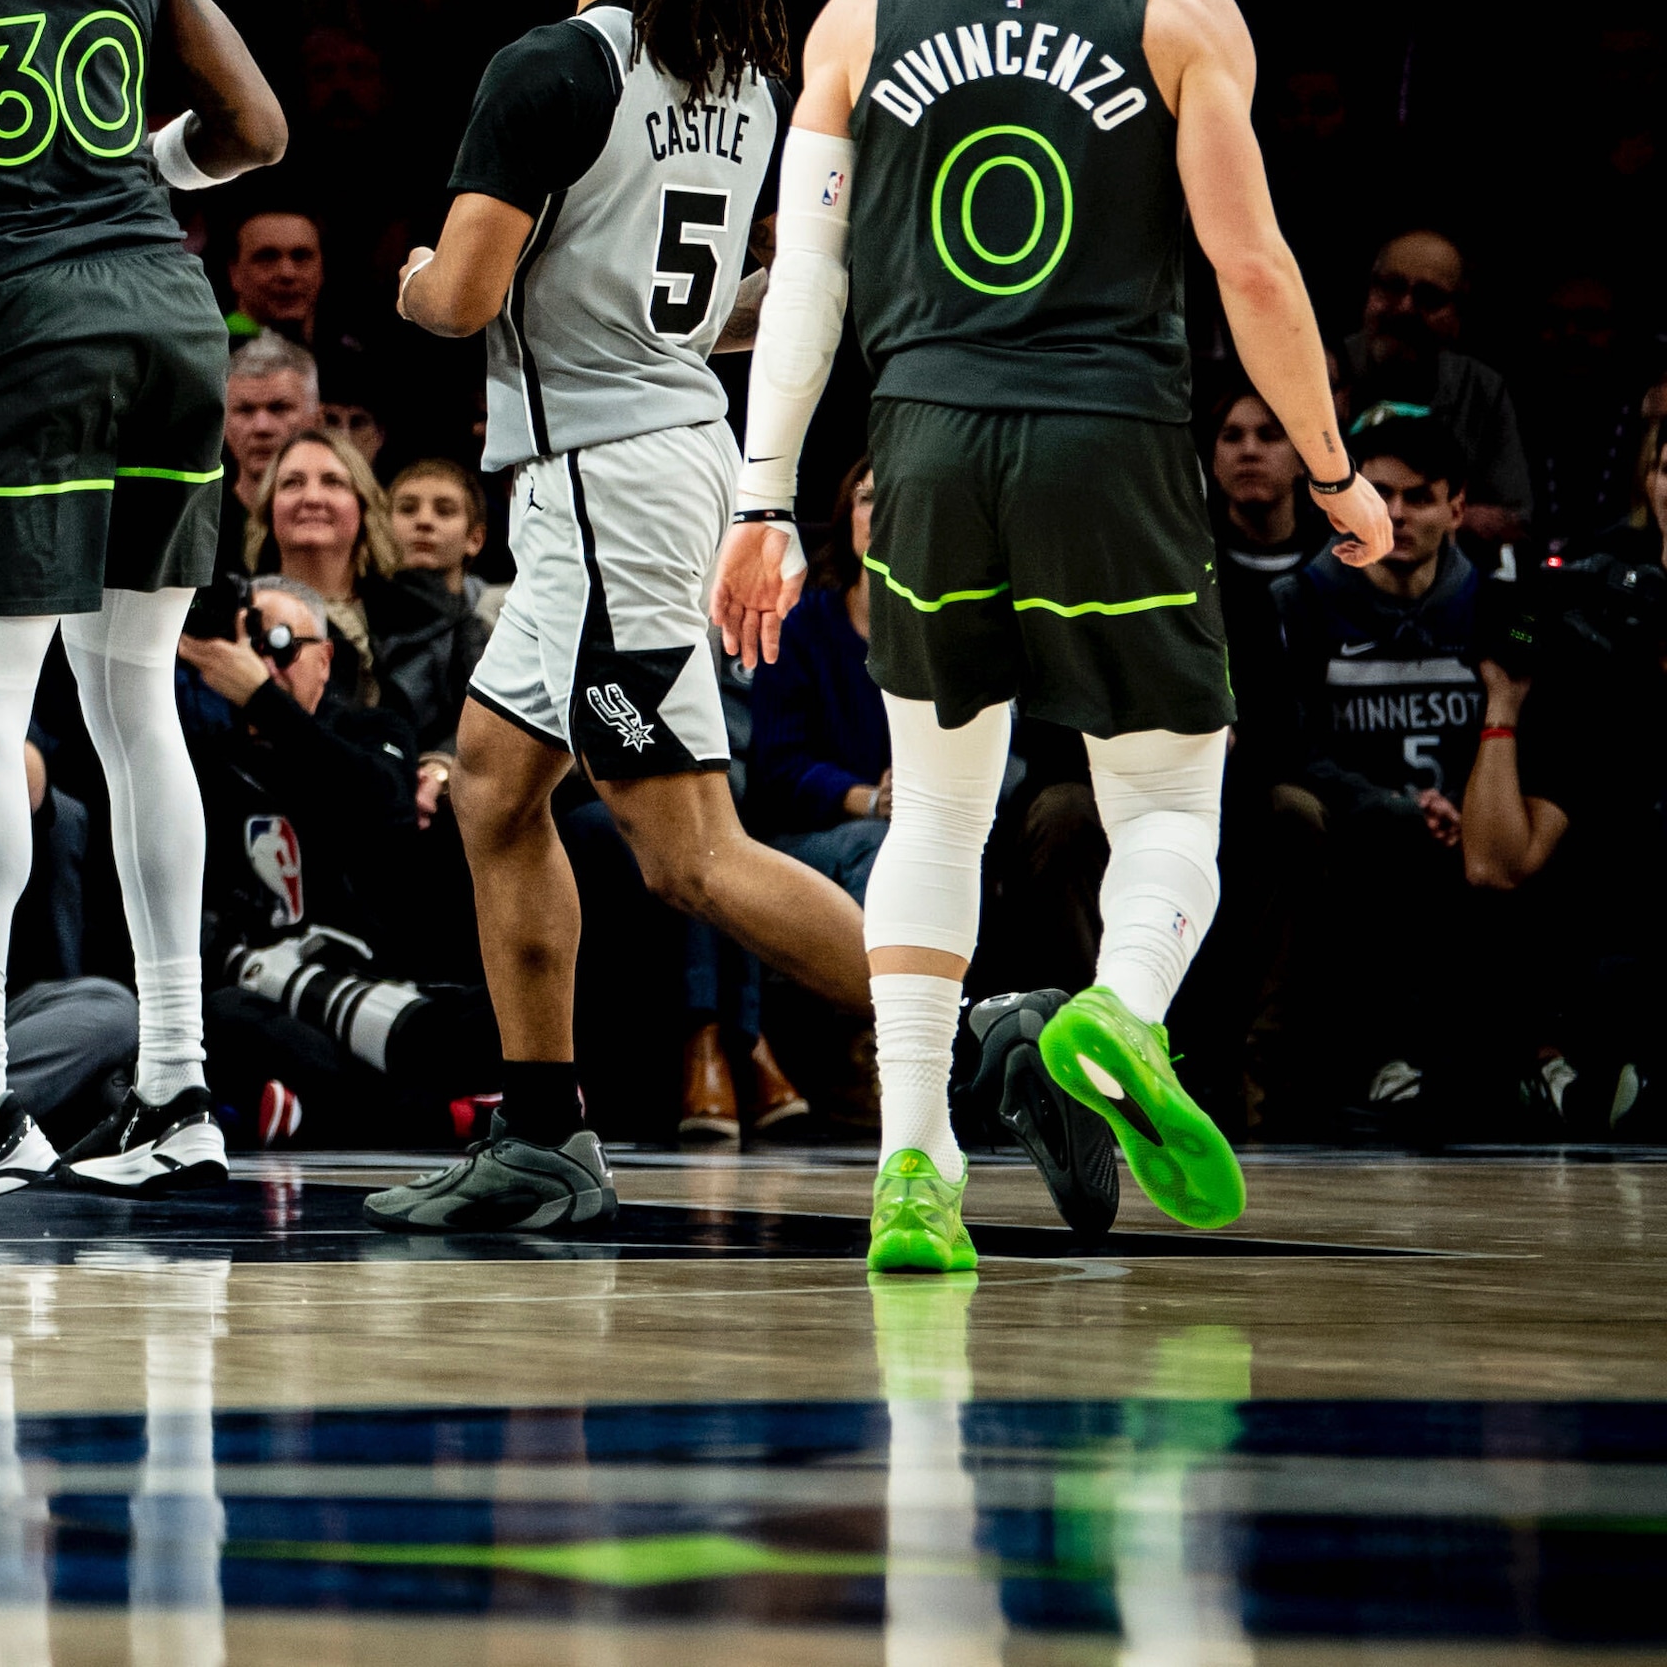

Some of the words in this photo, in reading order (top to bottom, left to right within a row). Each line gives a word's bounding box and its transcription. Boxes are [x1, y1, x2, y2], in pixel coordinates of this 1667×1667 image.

[870, 20, 1147, 131] DIVINCENZO
[646, 105, 750, 164] CASTLE
[930, 123, 1075, 297] 0
[646, 183, 732, 340] 5
[1331, 690, 1483, 733] MINNESOT
[1402, 734, 1445, 792] 5
